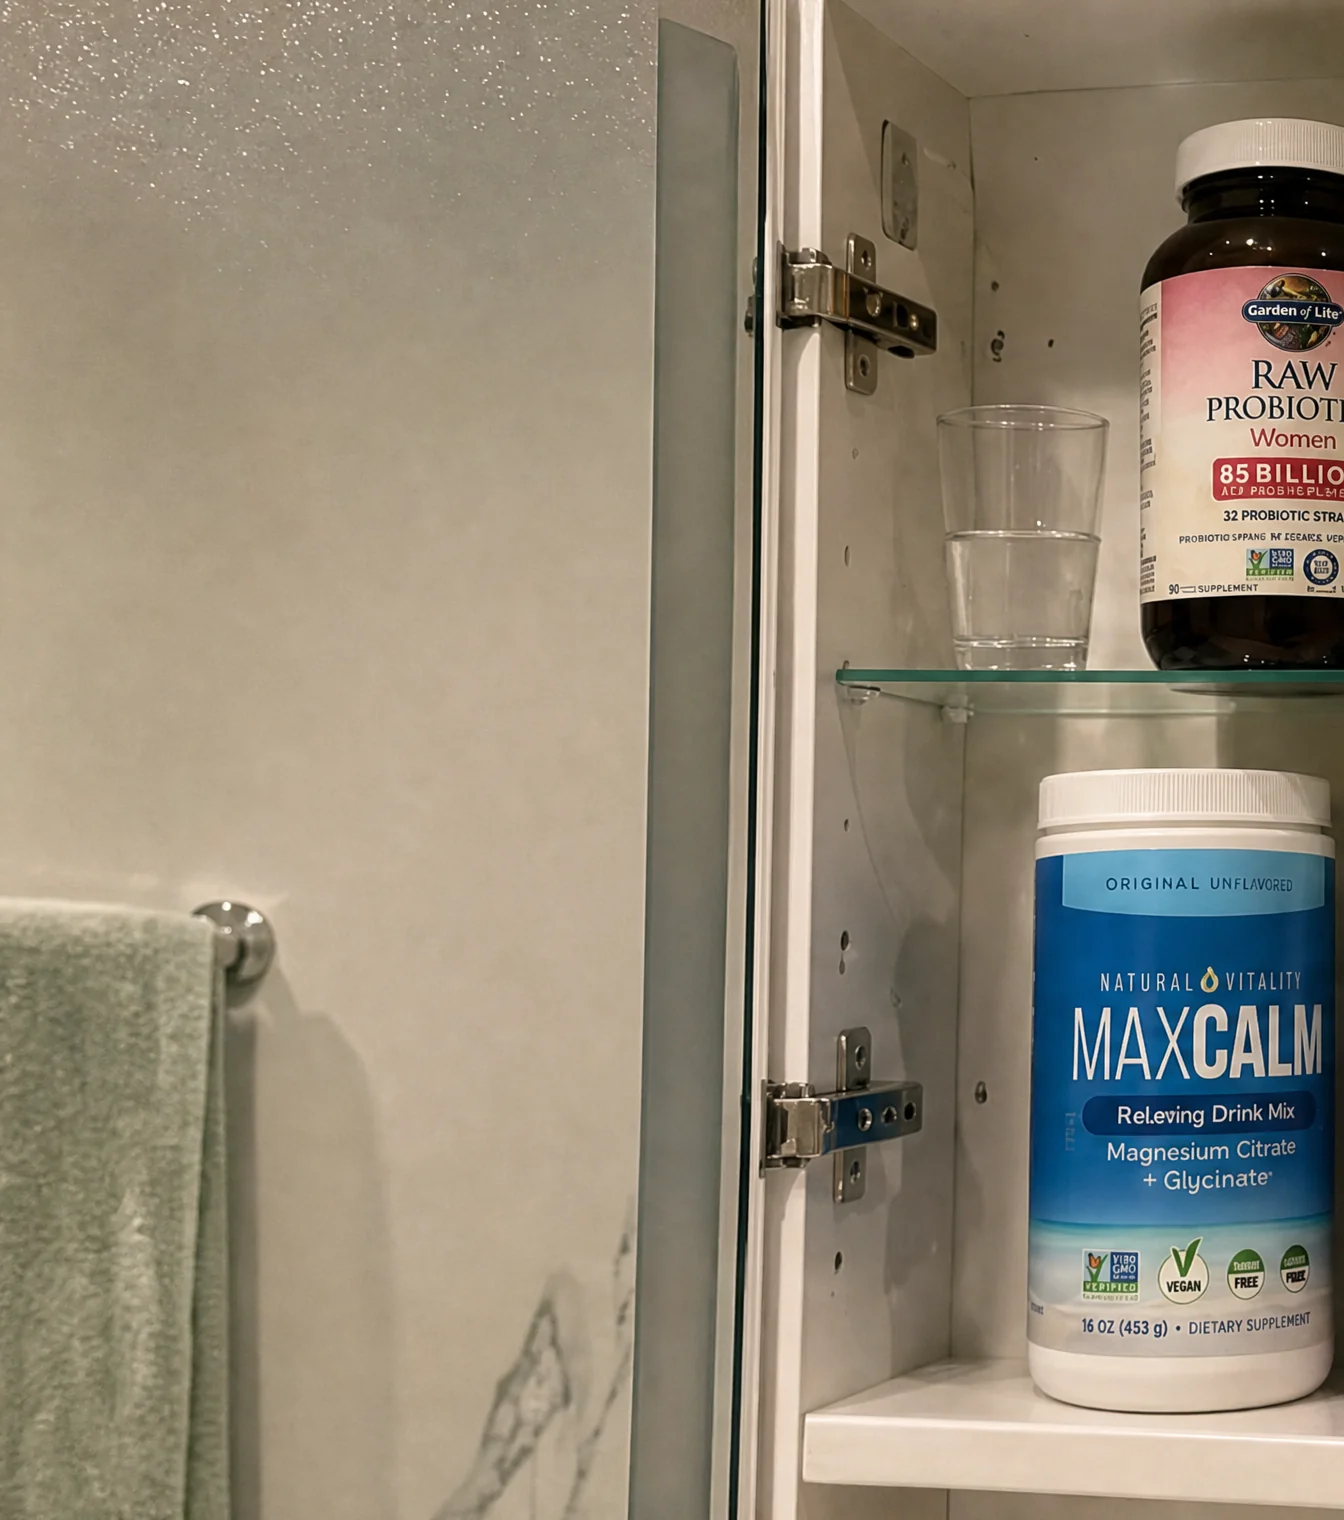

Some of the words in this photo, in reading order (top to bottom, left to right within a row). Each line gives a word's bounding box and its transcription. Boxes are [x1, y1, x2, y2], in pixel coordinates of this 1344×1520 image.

[1248, 304, 1297, 317] Garden
[1300, 305, 1312, 320] of
[1252, 359, 1338, 391] RAW
[1250, 428, 1336, 450] Women
[1220, 463, 1250, 484] 85
[1223, 510, 1239, 522] 32
[1242, 510, 1310, 522] PROBIOTIC
[1168, 583, 1180, 595] 90
[1198, 583, 1259, 593] SUPPLEMENT
[1106, 877, 1200, 891] ORIGINAL
[1210, 877, 1293, 892] UNFLAVORED
[1100, 972, 1193, 993] NATURAL
[1226, 971, 1302, 992] VITALITY
[1072, 1003, 1323, 1081] MAXCALM
[1212, 1105, 1264, 1123] Drink
[1268, 1102, 1296, 1121] Mix
[1107, 1142, 1230, 1167] Magnesium
[1236, 1139, 1296, 1159] Citrate
[1166, 1281, 1201, 1293] VEGAN
[1234, 1276, 1259, 1290] FREE
[1082, 1318, 1095, 1333] 16
[1097, 1319, 1115, 1333] OZ
[1118, 1319, 1150, 1337] (453
[1153, 1320, 1168, 1337] g)
[1188, 1320, 1243, 1336] DIETARY
[1246, 1312, 1311, 1332] SUPPLEMENT
